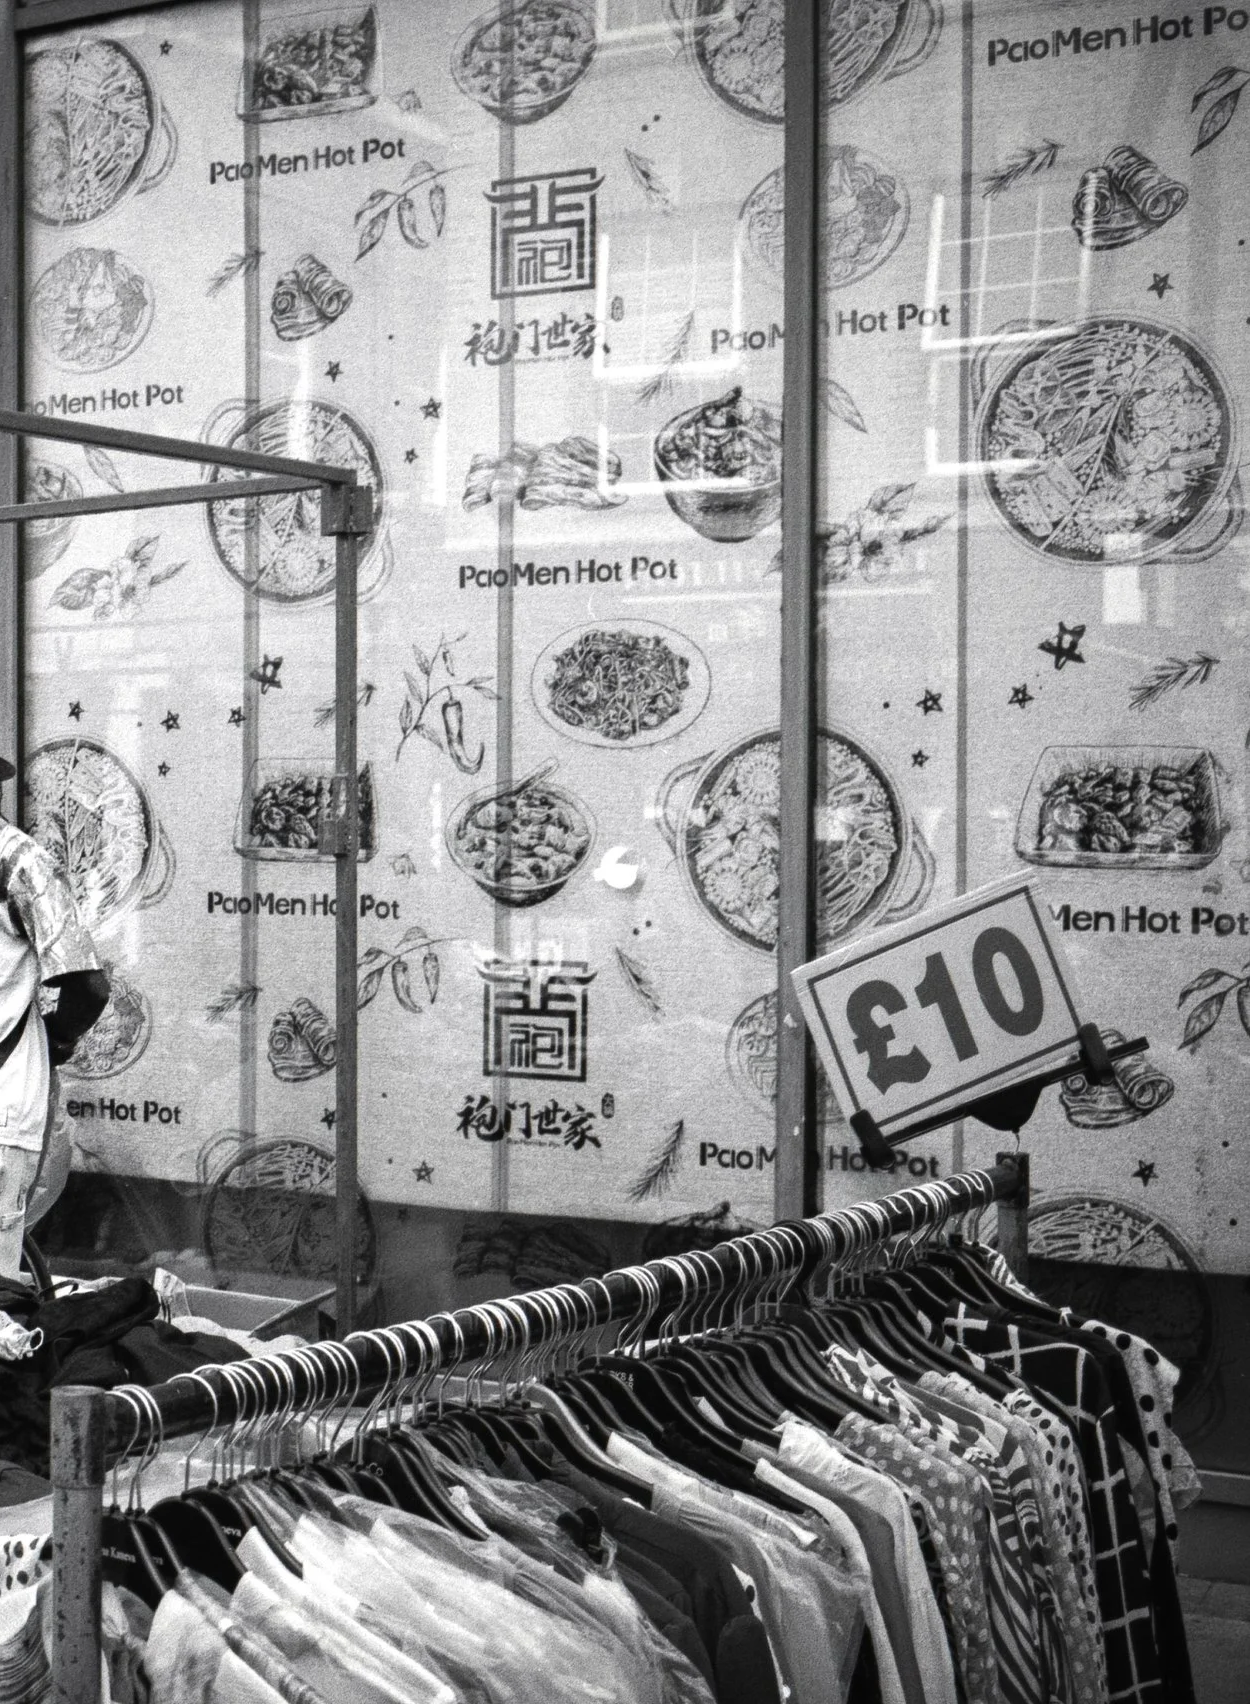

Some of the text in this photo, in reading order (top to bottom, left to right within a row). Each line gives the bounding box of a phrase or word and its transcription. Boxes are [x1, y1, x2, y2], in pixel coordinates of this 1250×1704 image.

[988, 6, 1249, 67] Pao Men Hot Po
[210, 137, 406, 185] Pao Men Hot Pot
[836, 309, 888, 336] Hot
[898, 303, 950, 330] Pot
[50, 393, 97, 415] Men
[101, 388, 139, 411] Hot
[146, 384, 185, 407] Pot
[459, 556, 679, 588] Pao Men Hot Pot
[208, 891, 400, 919] Pao Men Ho Pot
[1122, 905, 1181, 934] Hot
[1191, 907, 1249, 937] Pot
[846, 926, 1045, 1096] £10
[66, 1098, 181, 1125] en Hot Pot
[700, 1142, 754, 1169] Pao
